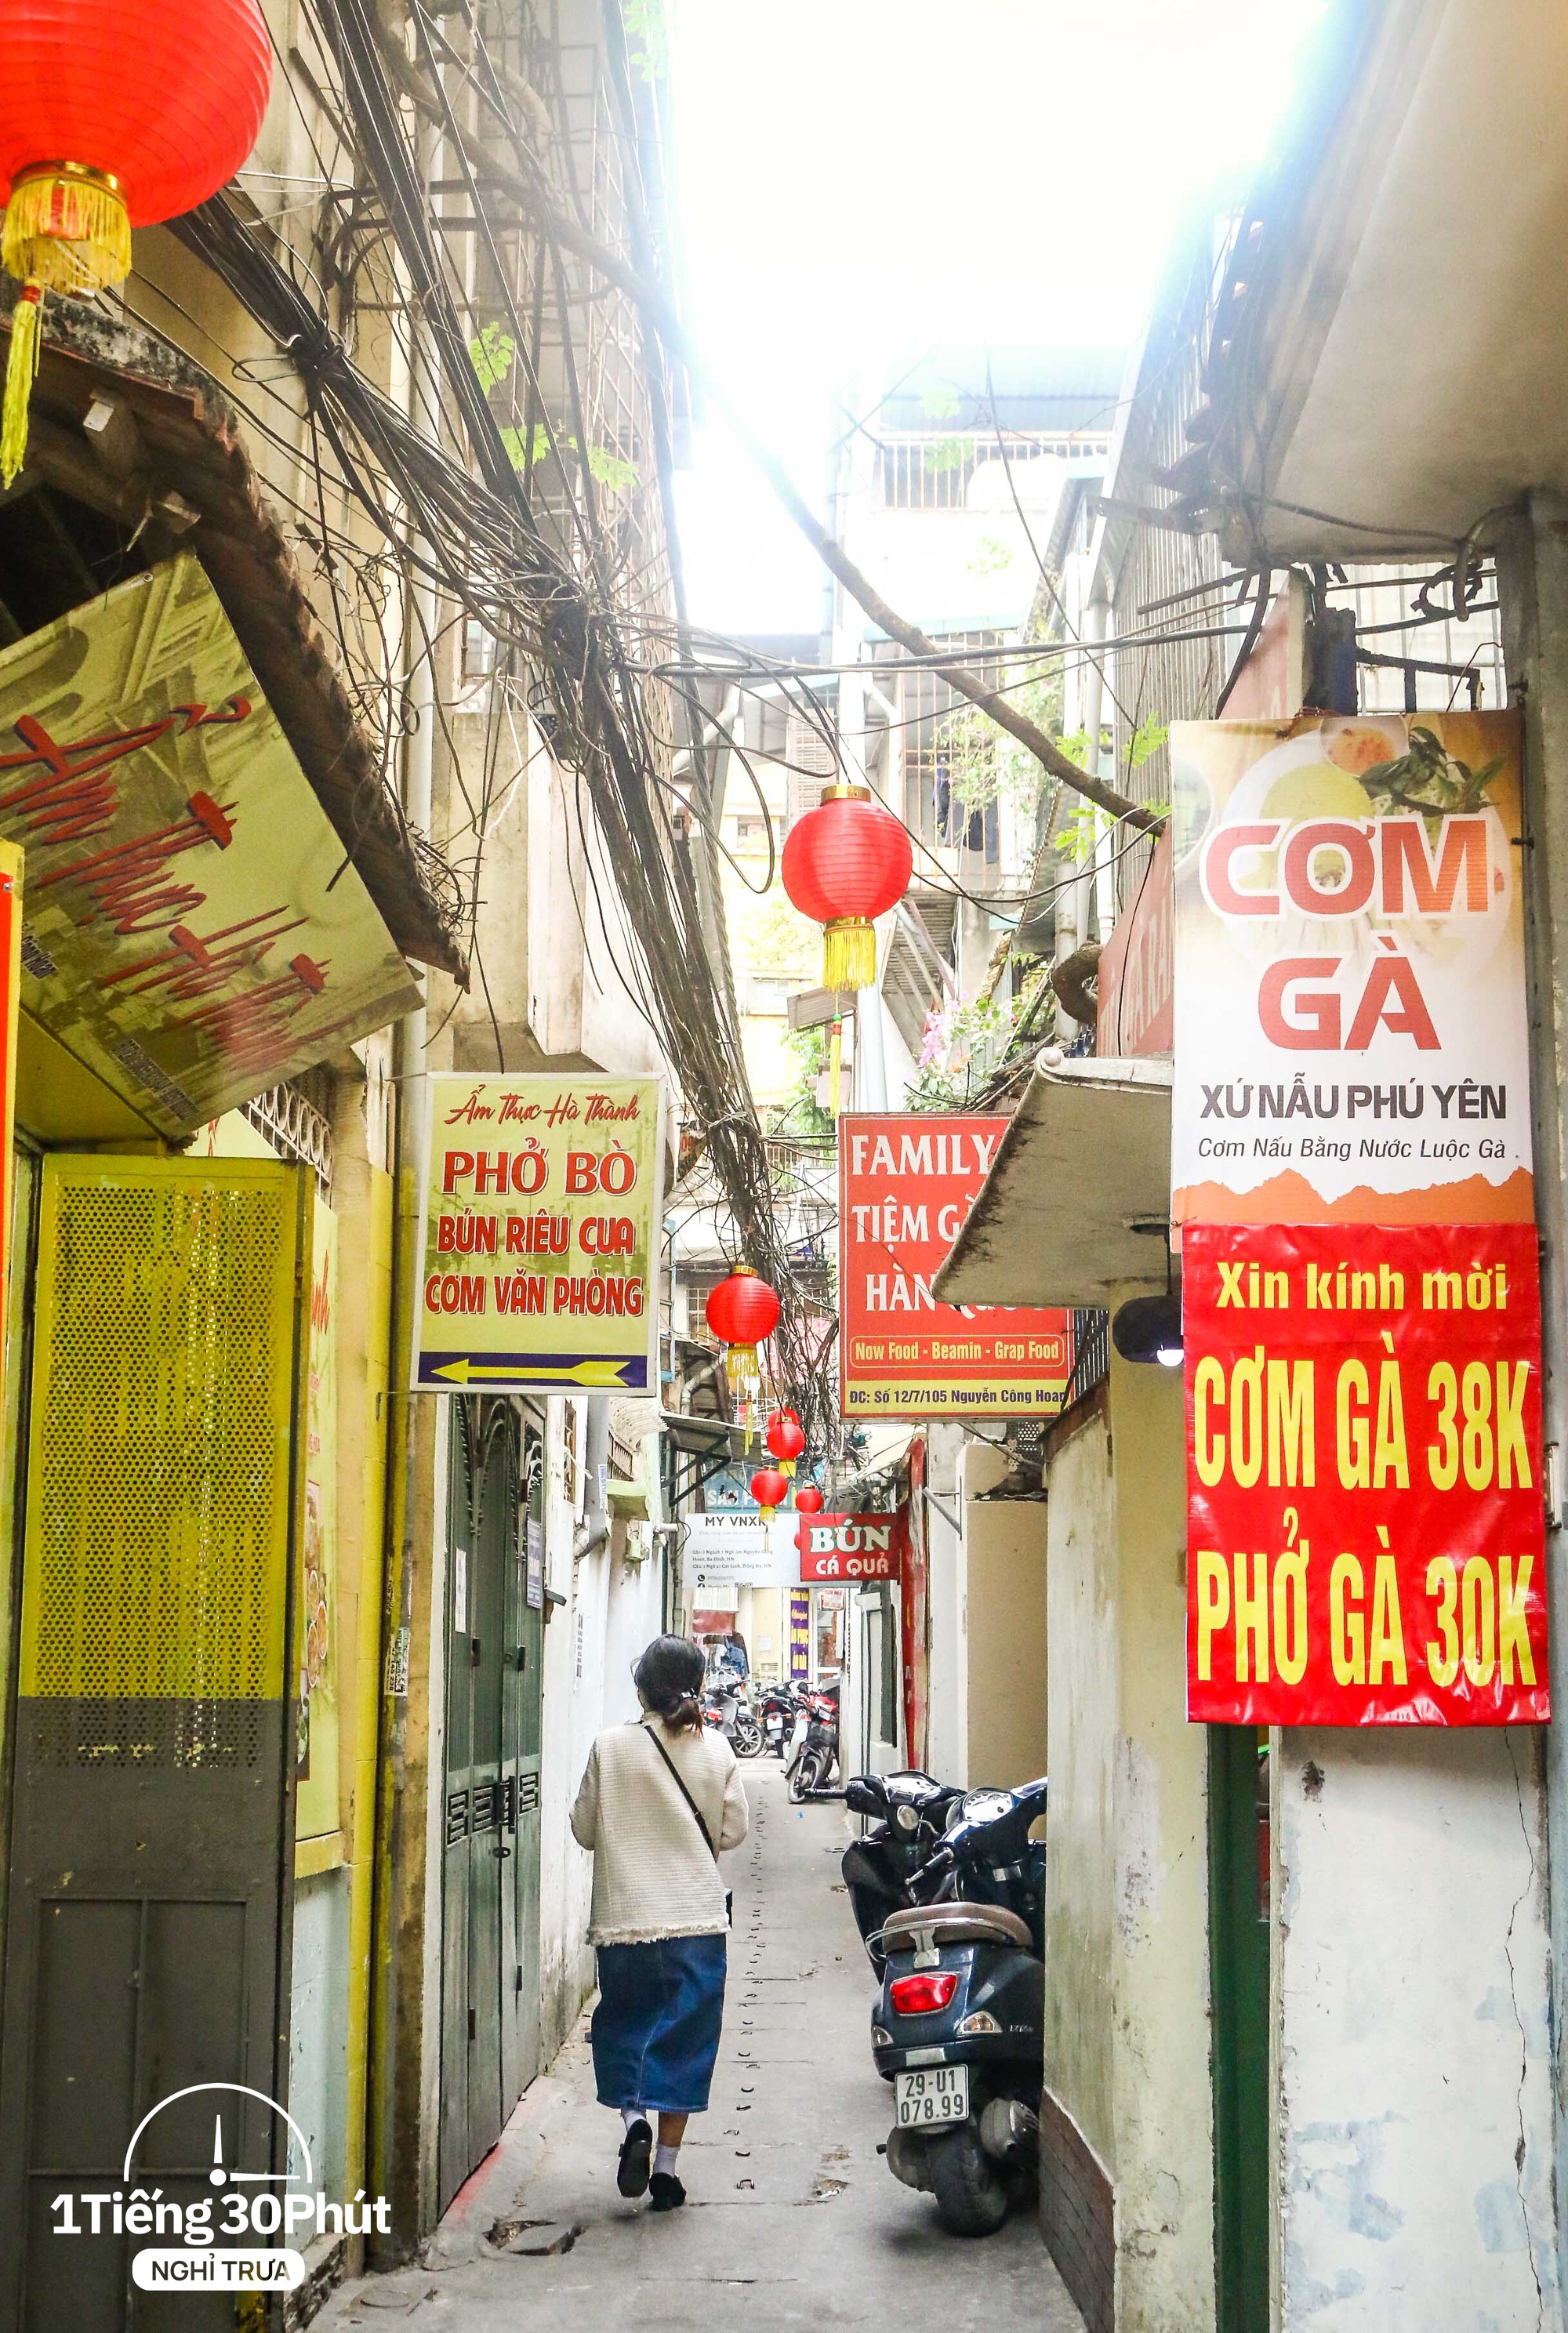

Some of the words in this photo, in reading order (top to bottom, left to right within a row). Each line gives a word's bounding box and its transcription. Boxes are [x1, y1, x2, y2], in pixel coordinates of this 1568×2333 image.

[1205, 820, 1489, 915] CƠM
[101, 904, 310, 1002] Hà
[1258, 937, 1442, 1050] GÀ
[444, 1084, 495, 1125] Ẩm
[494, 1094, 542, 1123] Thực
[543, 1093, 581, 1128] Hà
[583, 1094, 641, 1125] Thành
[1200, 1077, 1254, 1119] XỨ
[1258, 1072, 1339, 1119] NẪU
[1348, 1077, 1423, 1119] PHÚ
[1432, 1078, 1506, 1119] YÊN
[441, 1136, 550, 1196] PHỞ
[564, 1139, 638, 1196] BÒ
[851, 1134, 995, 1175] FAMILY
[1198, 1138, 1245, 1158] Cơm
[1253, 1136, 1292, 1159] Nấu
[1301, 1136, 1351, 1162] Bằng
[1359, 1137, 1412, 1159] Nước
[1420, 1138, 1470, 1162] Luộc
[1479, 1137, 1506, 1159] Gà
[437, 1208, 499, 1254] BÚN
[506, 1208, 570, 1256] RIÊU
[579, 1216, 636, 1257] CUA
[851, 1195, 930, 1254] TIỆM
[425, 1274, 486, 1315] CƠM
[494, 1268, 546, 1316] VĂN
[553, 1268, 644, 1318] PHÒNG
[866, 1263, 938, 1312] HÀN
[1216, 1262, 1289, 1309] Xin
[1306, 1261, 1404, 1310] kính
[1422, 1263, 1506, 1311] mời
[855, 1342, 884, 1360] Now
[888, 1342, 919, 1360] Food
[932, 1341, 982, 1360] Beamin
[994, 1341, 1025, 1362] Grap
[1029, 1340, 1059, 1360] Food
[874, 1388, 891, 1404] Số
[894, 1391, 947, 1404] 12/7/105
[952, 1387, 997, 1406] Nguyễn
[1001, 1388, 1033, 1406] Công
[1194, 1345, 1315, 1488] CƠM
[1336, 1331, 1410, 1490] GÀ
[1427, 1361, 1533, 1491] 38K
[705, 1516, 724, 1527] MY
[809, 1518, 891, 1553] BÚN
[815, 1555, 840, 1575] CÁ
[846, 1552, 889, 1576] QUẢ
[1196, 1507, 1310, 1686] PHỞ
[1330, 1526, 1409, 1686] GÀ
[1425, 1555, 1537, 1687] 30K
[906, 2070, 956, 2099] 29-U1
[901, 2094, 964, 2124] 078.99
